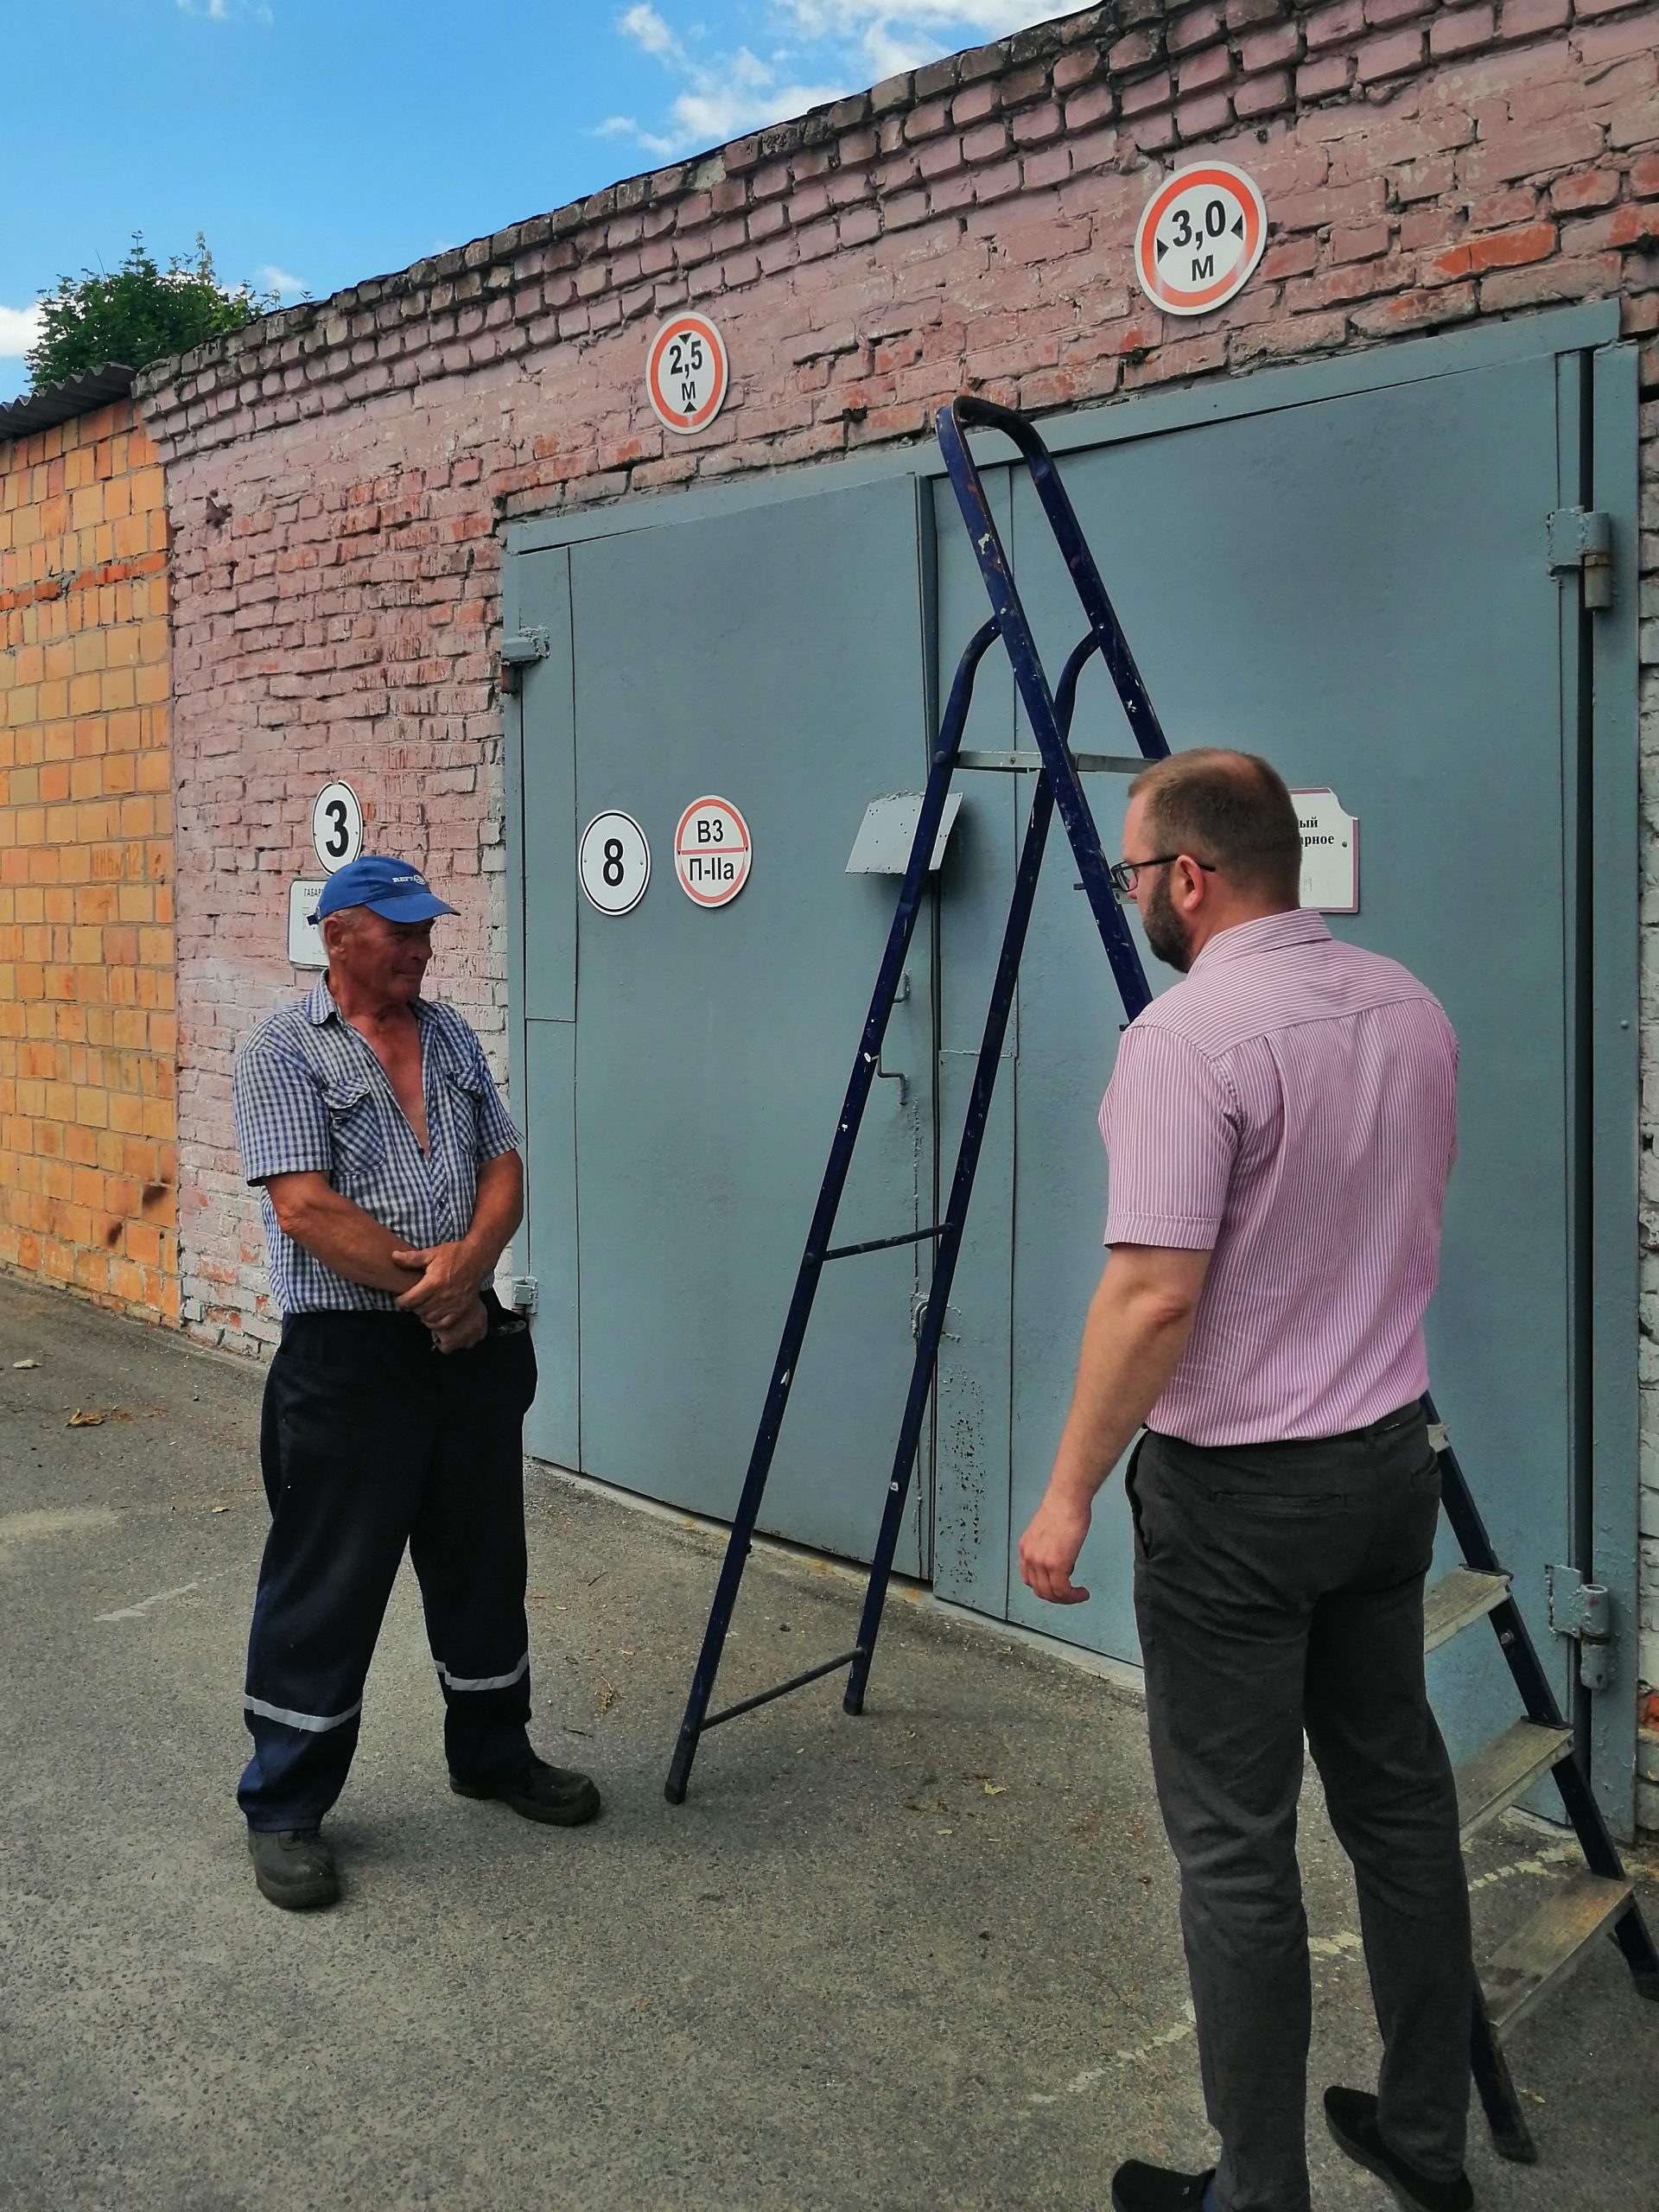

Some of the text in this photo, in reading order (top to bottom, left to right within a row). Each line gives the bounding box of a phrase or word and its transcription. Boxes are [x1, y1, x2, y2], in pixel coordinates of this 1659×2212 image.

[1172, 200, 1226, 251] 3,0
[1192, 254, 1214, 282] М
[669, 340, 703, 379] 2,5
[681, 381, 696, 402] М
[325, 799, 349, 858] 3
[697, 819, 724, 843] В3
[1300, 816, 1319, 829] ый
[602, 837, 625, 887] 8
